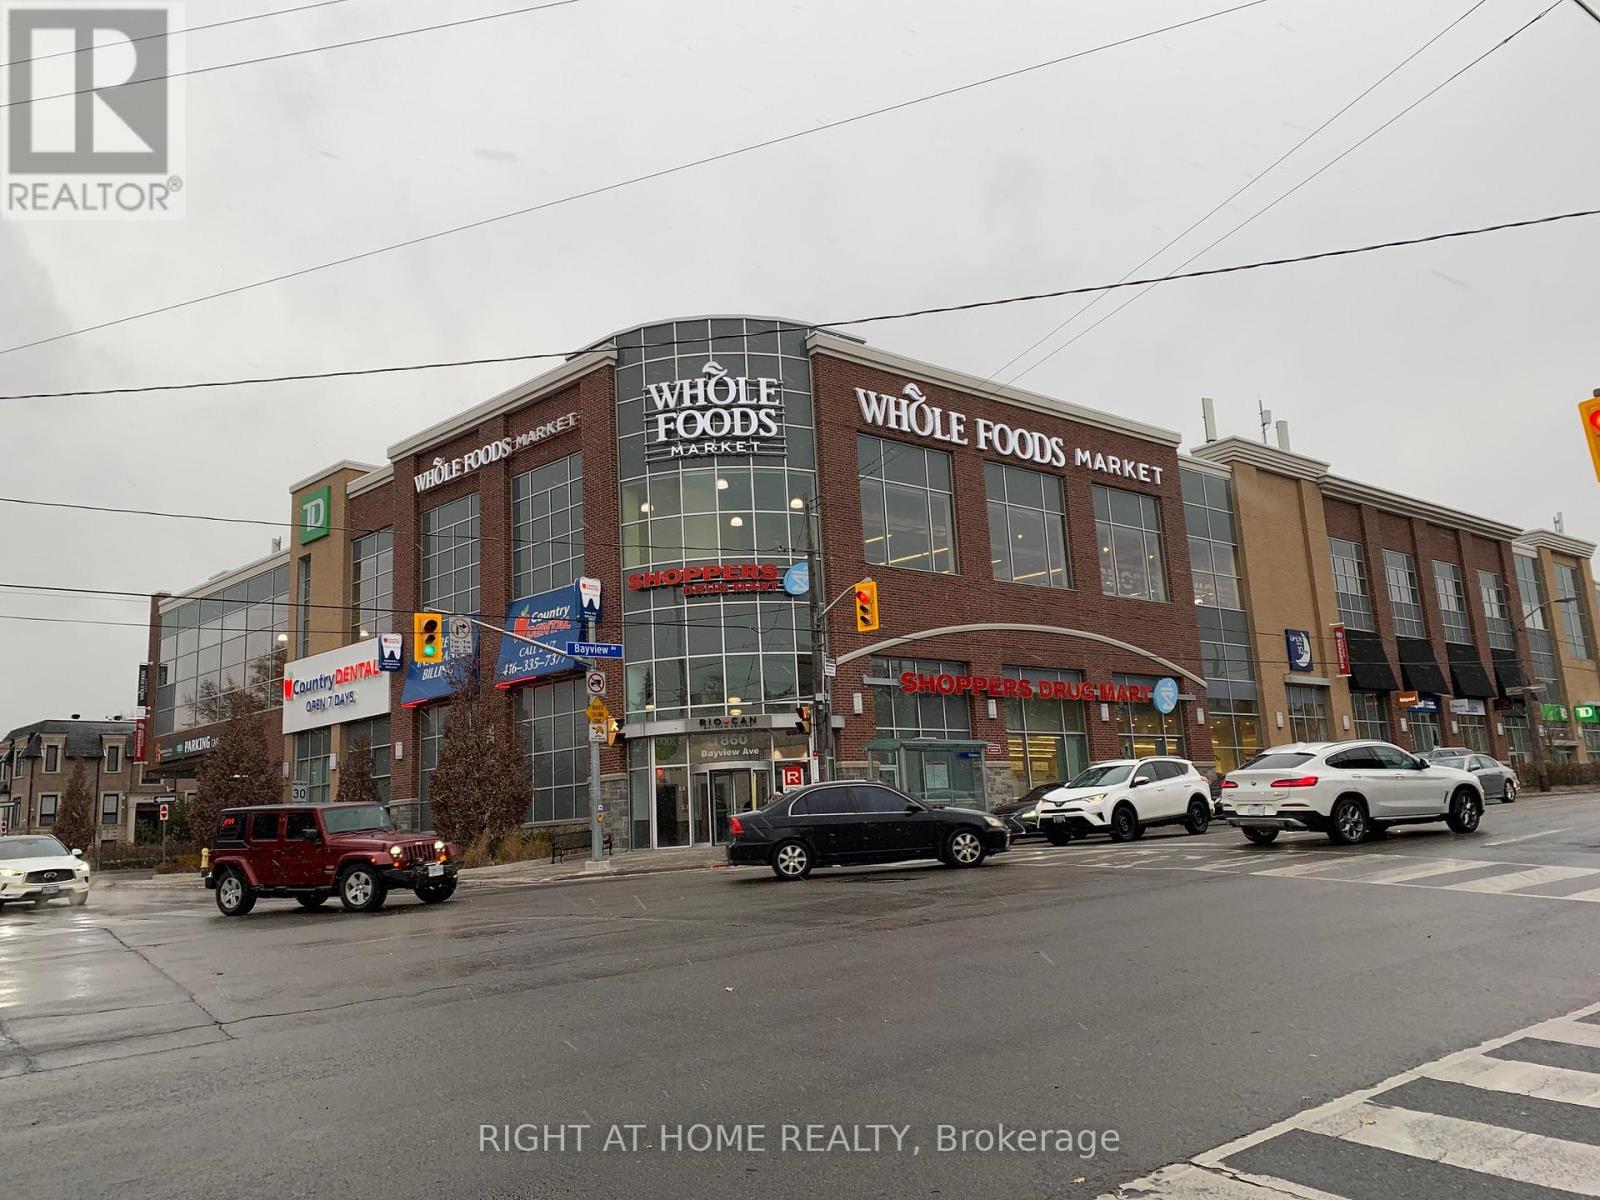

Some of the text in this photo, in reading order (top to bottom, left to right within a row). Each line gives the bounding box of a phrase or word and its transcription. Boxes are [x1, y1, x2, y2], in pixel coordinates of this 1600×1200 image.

[646, 376, 780, 411] WHOLE
[655, 407, 778, 442] FOODS
[854, 386, 1164, 485] WHOLE FOODS MARKET
[413, 412, 580, 493] WHOLE FOODS MARKET
[671, 441, 761, 457] MARKET
[302, 498, 325, 532] TD
[627, 563, 779, 591] SHOPPERS
[531, 604, 571, 623] Country
[574, 643, 609, 656] Bayview
[900, 671, 1152, 703] SHOPPERS DRUG MART
[305, 691, 356, 713] OPEN 7 DAYS
[1575, 707, 1593, 718] TD
[184, 735, 210, 754] PARKING
[701, 747, 760, 759] Bayview Ave
[786, 771, 799, 784] R
[293, 788, 306, 799] 30
